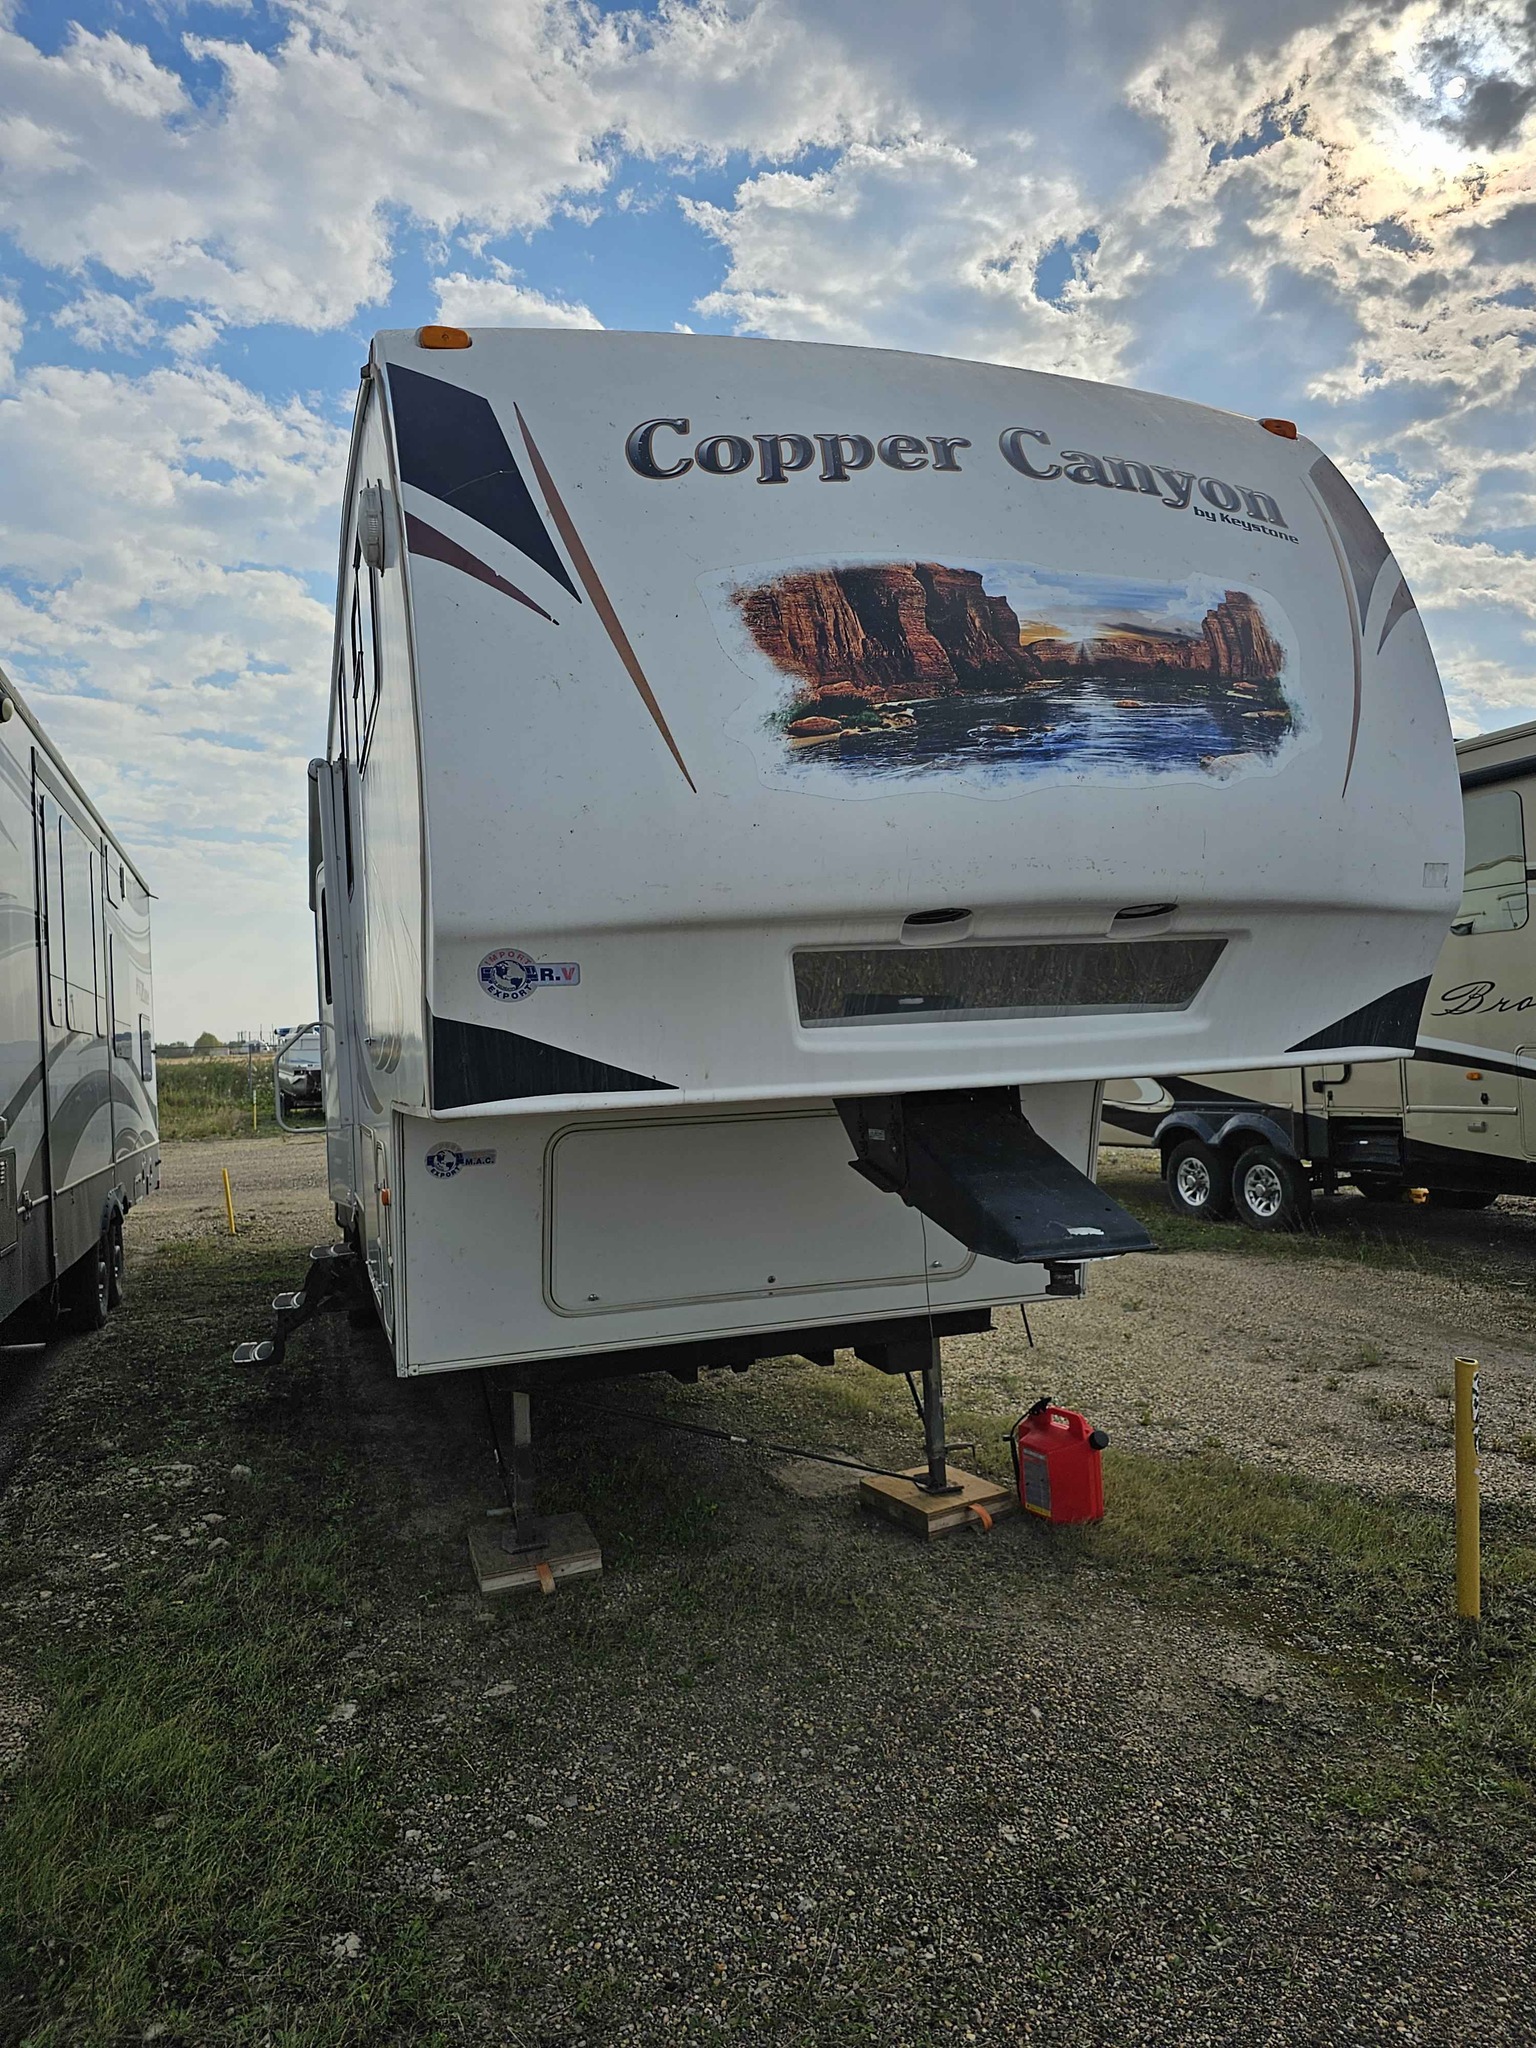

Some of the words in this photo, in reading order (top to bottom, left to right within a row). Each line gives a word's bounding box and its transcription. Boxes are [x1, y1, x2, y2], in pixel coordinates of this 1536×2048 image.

[625, 418, 972, 484] Copper
[998, 426, 1289, 529] Canyon
[1193, 506, 1217, 522] by
[1219, 512, 1300, 544] Keystone
[485, 951, 531, 965] IMPORT
[487, 984, 532, 999] EXPORT
[465, 1157, 494, 1165] M.A.C.
[431, 1166, 460, 1177] EXPORT
